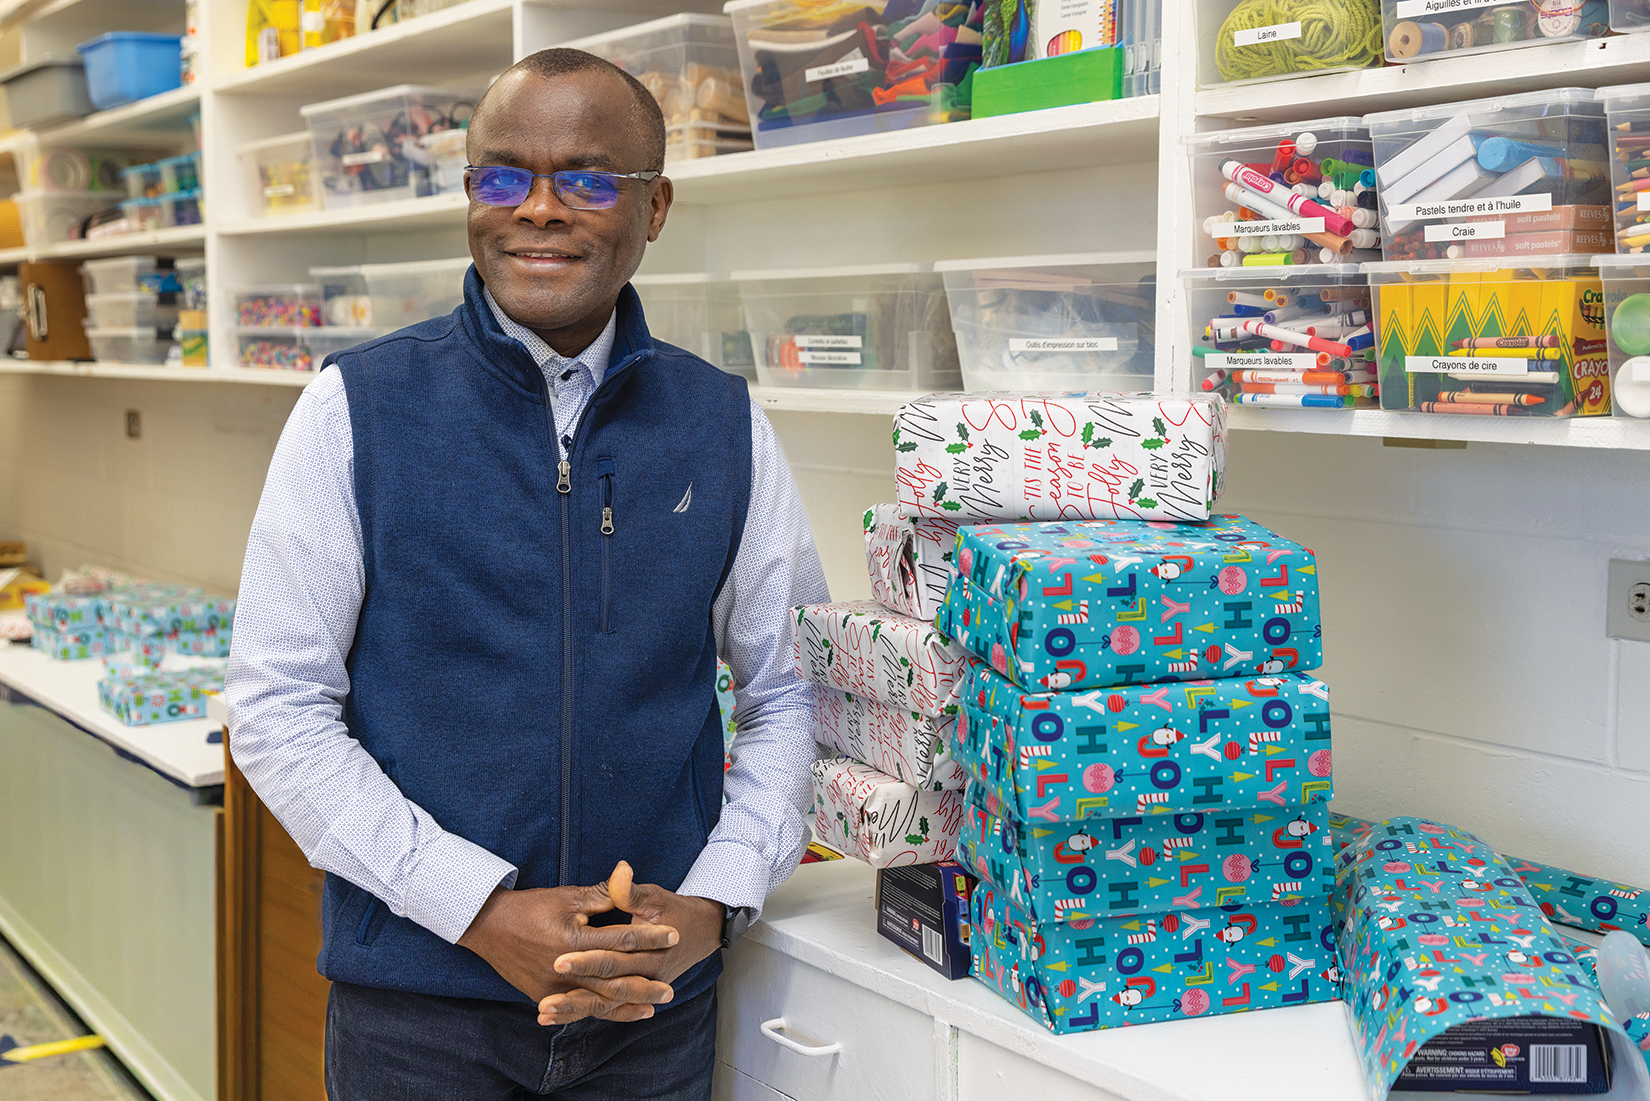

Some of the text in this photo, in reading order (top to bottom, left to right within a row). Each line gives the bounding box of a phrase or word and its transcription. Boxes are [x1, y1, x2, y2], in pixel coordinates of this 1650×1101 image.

[1425, 0, 1461, 11] Aiguilles
[1257, 29, 1277, 40] Laine
[1243, 172, 1273, 192] Crayola
[1415, 199, 1522, 216] Pastels tendre et à l'huile
[1516, 214, 1532, 224] soft
[1533, 212, 1561, 223] pastels
[1579, 209, 1602, 219] REEVES
[1234, 221, 1301, 234] Marqueurs lavables
[1452, 226, 1476, 237] Craie
[1576, 234, 1599, 245] REEVES
[1471, 239, 1560, 253] REEVES soft pastels
[1025, 341, 1041, 349] Outils
[1042, 340, 1075, 350] d'impression
[1086, 340, 1099, 349] bloc
[1498, 339, 1527, 347] Crayola
[1226, 356, 1293, 367] Marqueurs lavables
[1431, 359, 1498, 371] Crayons de cire
[1589, 386, 1602, 400] 24
[1023, 445, 1042, 471] THE
[952, 456, 971, 492] VERY
[1066, 451, 1085, 499] TO BE
[1150, 453, 1169, 489] VERY
